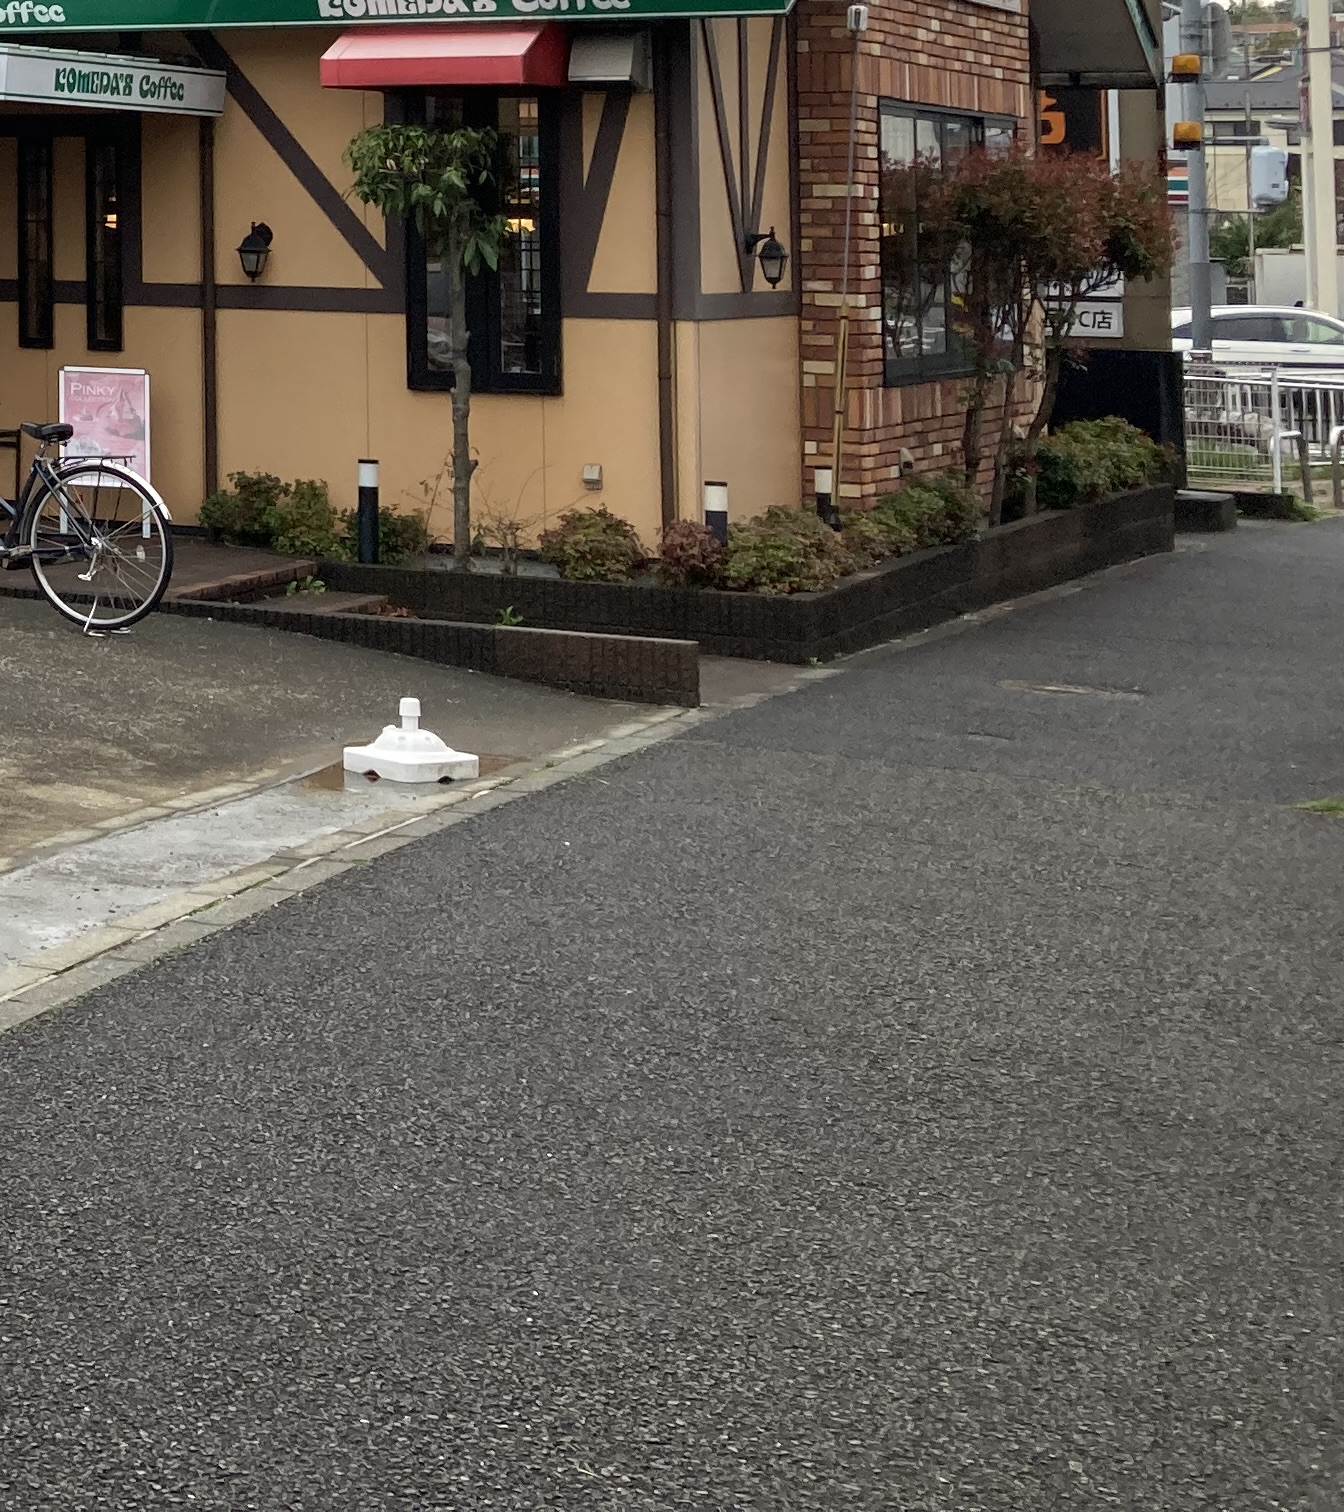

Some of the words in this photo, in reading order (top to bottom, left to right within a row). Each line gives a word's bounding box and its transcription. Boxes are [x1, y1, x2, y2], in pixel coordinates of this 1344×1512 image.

[54, 67, 134, 98] KOMEDA'S
[138, 75, 185, 102] Coffee
[70, 382, 115, 397] PINKY
